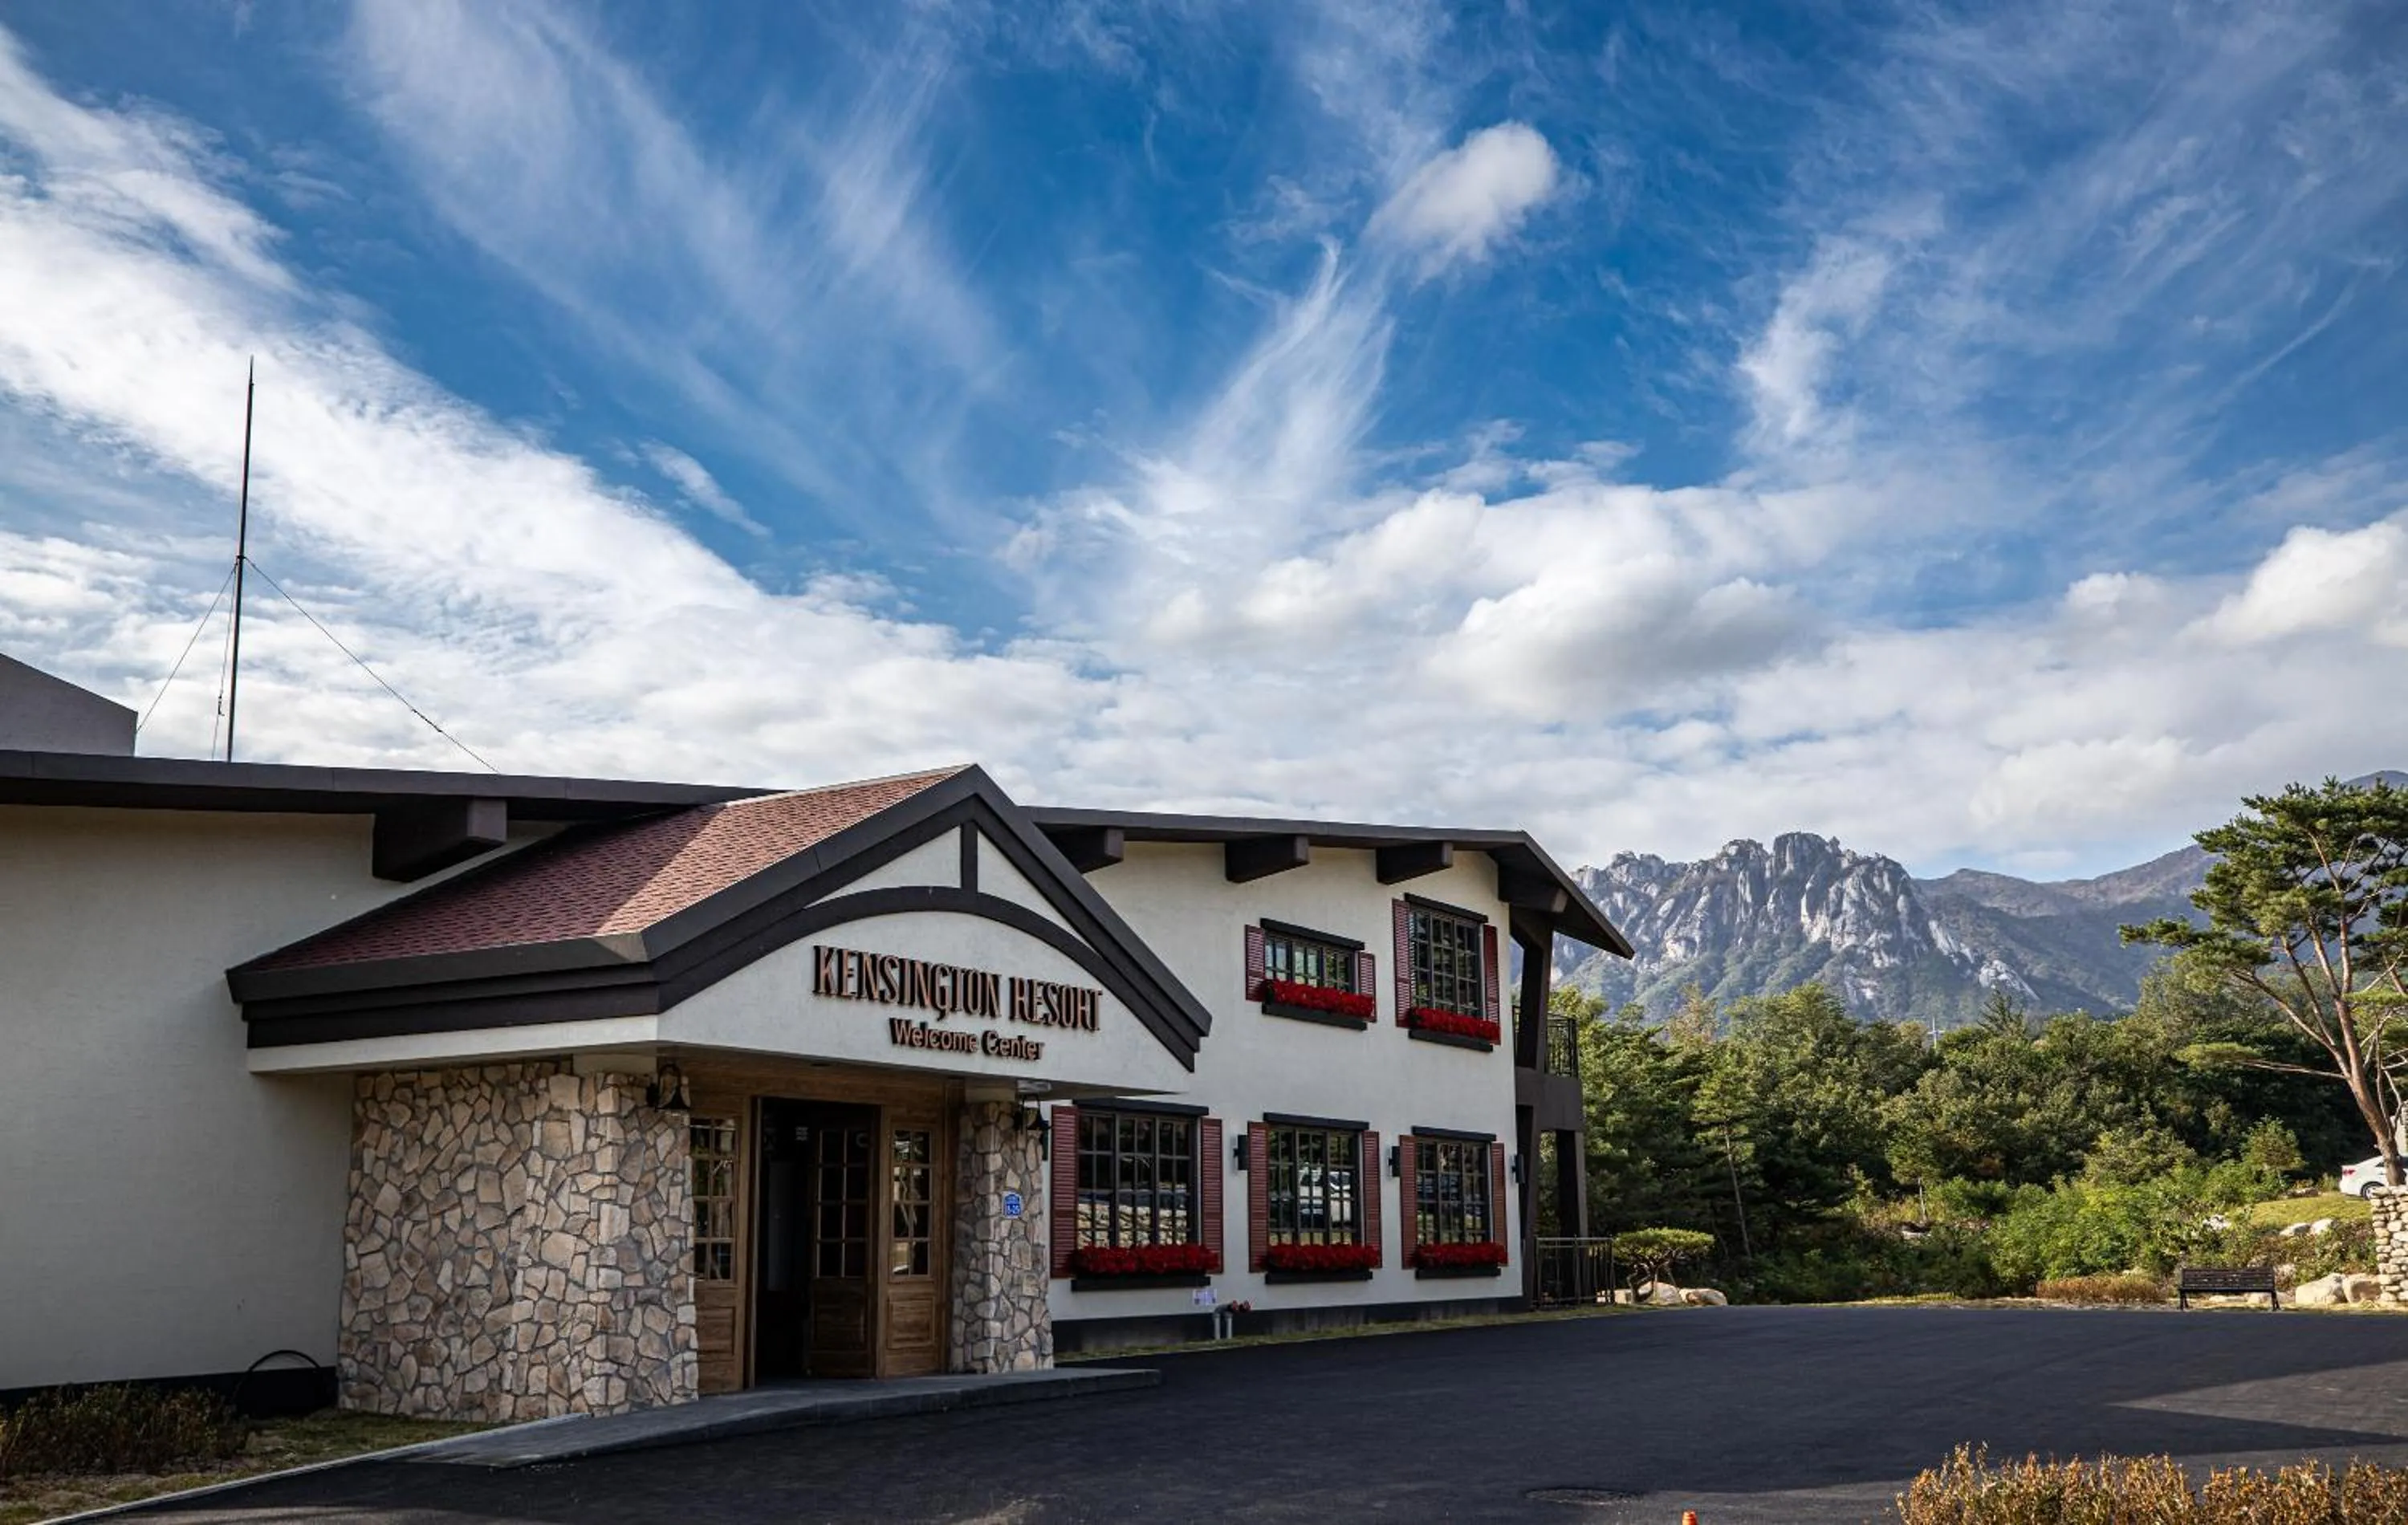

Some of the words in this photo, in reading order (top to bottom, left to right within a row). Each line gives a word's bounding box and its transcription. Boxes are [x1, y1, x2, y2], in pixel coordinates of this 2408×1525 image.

[813, 946, 1002, 1021] KENSINGTON
[1009, 977, 1103, 1031] RESORT
[889, 1018, 978, 1053] Welcome
[982, 1031, 1044, 1059] Center
